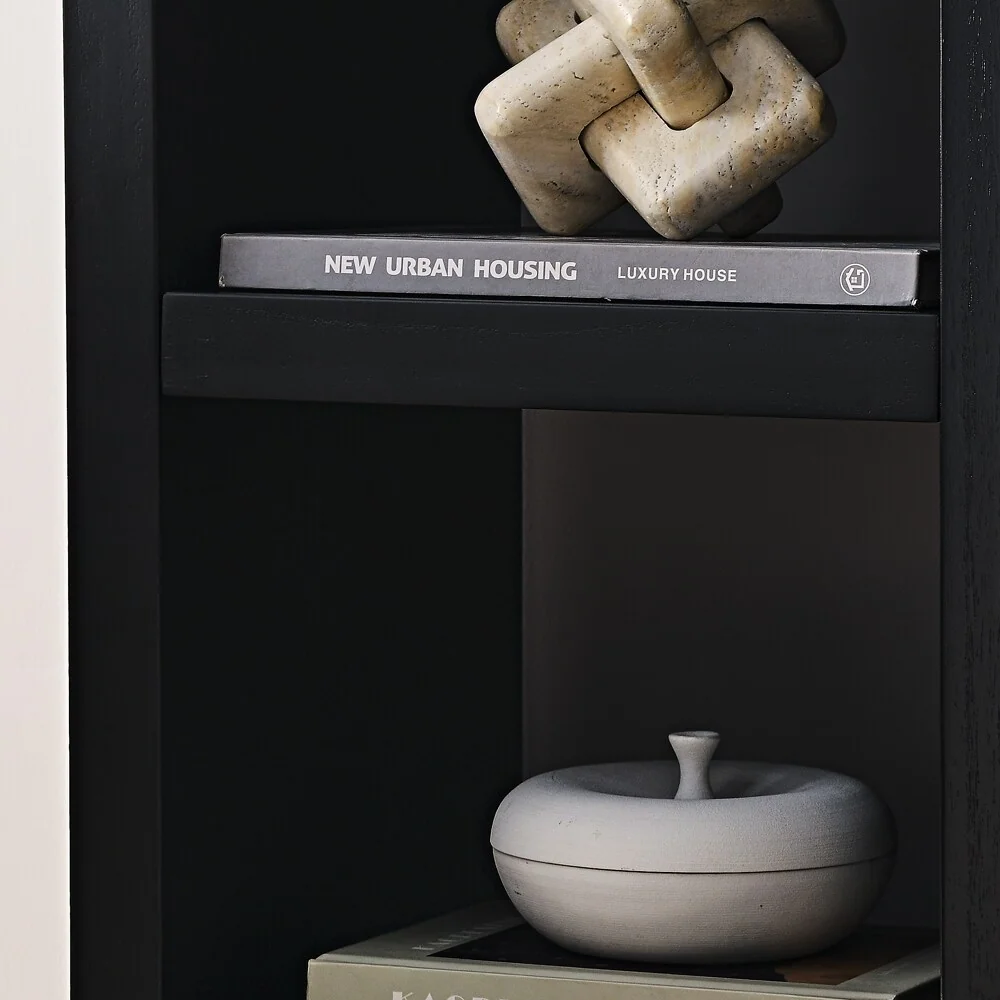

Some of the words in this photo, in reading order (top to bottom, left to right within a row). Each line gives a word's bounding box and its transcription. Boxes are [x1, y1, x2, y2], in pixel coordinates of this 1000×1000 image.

[325, 254, 377, 275] NEW
[387, 257, 464, 278] URBAN
[473, 260, 578, 281] HOUSING
[617, 266, 680, 281] LUXURY
[684, 268, 737, 282] HOUSE
